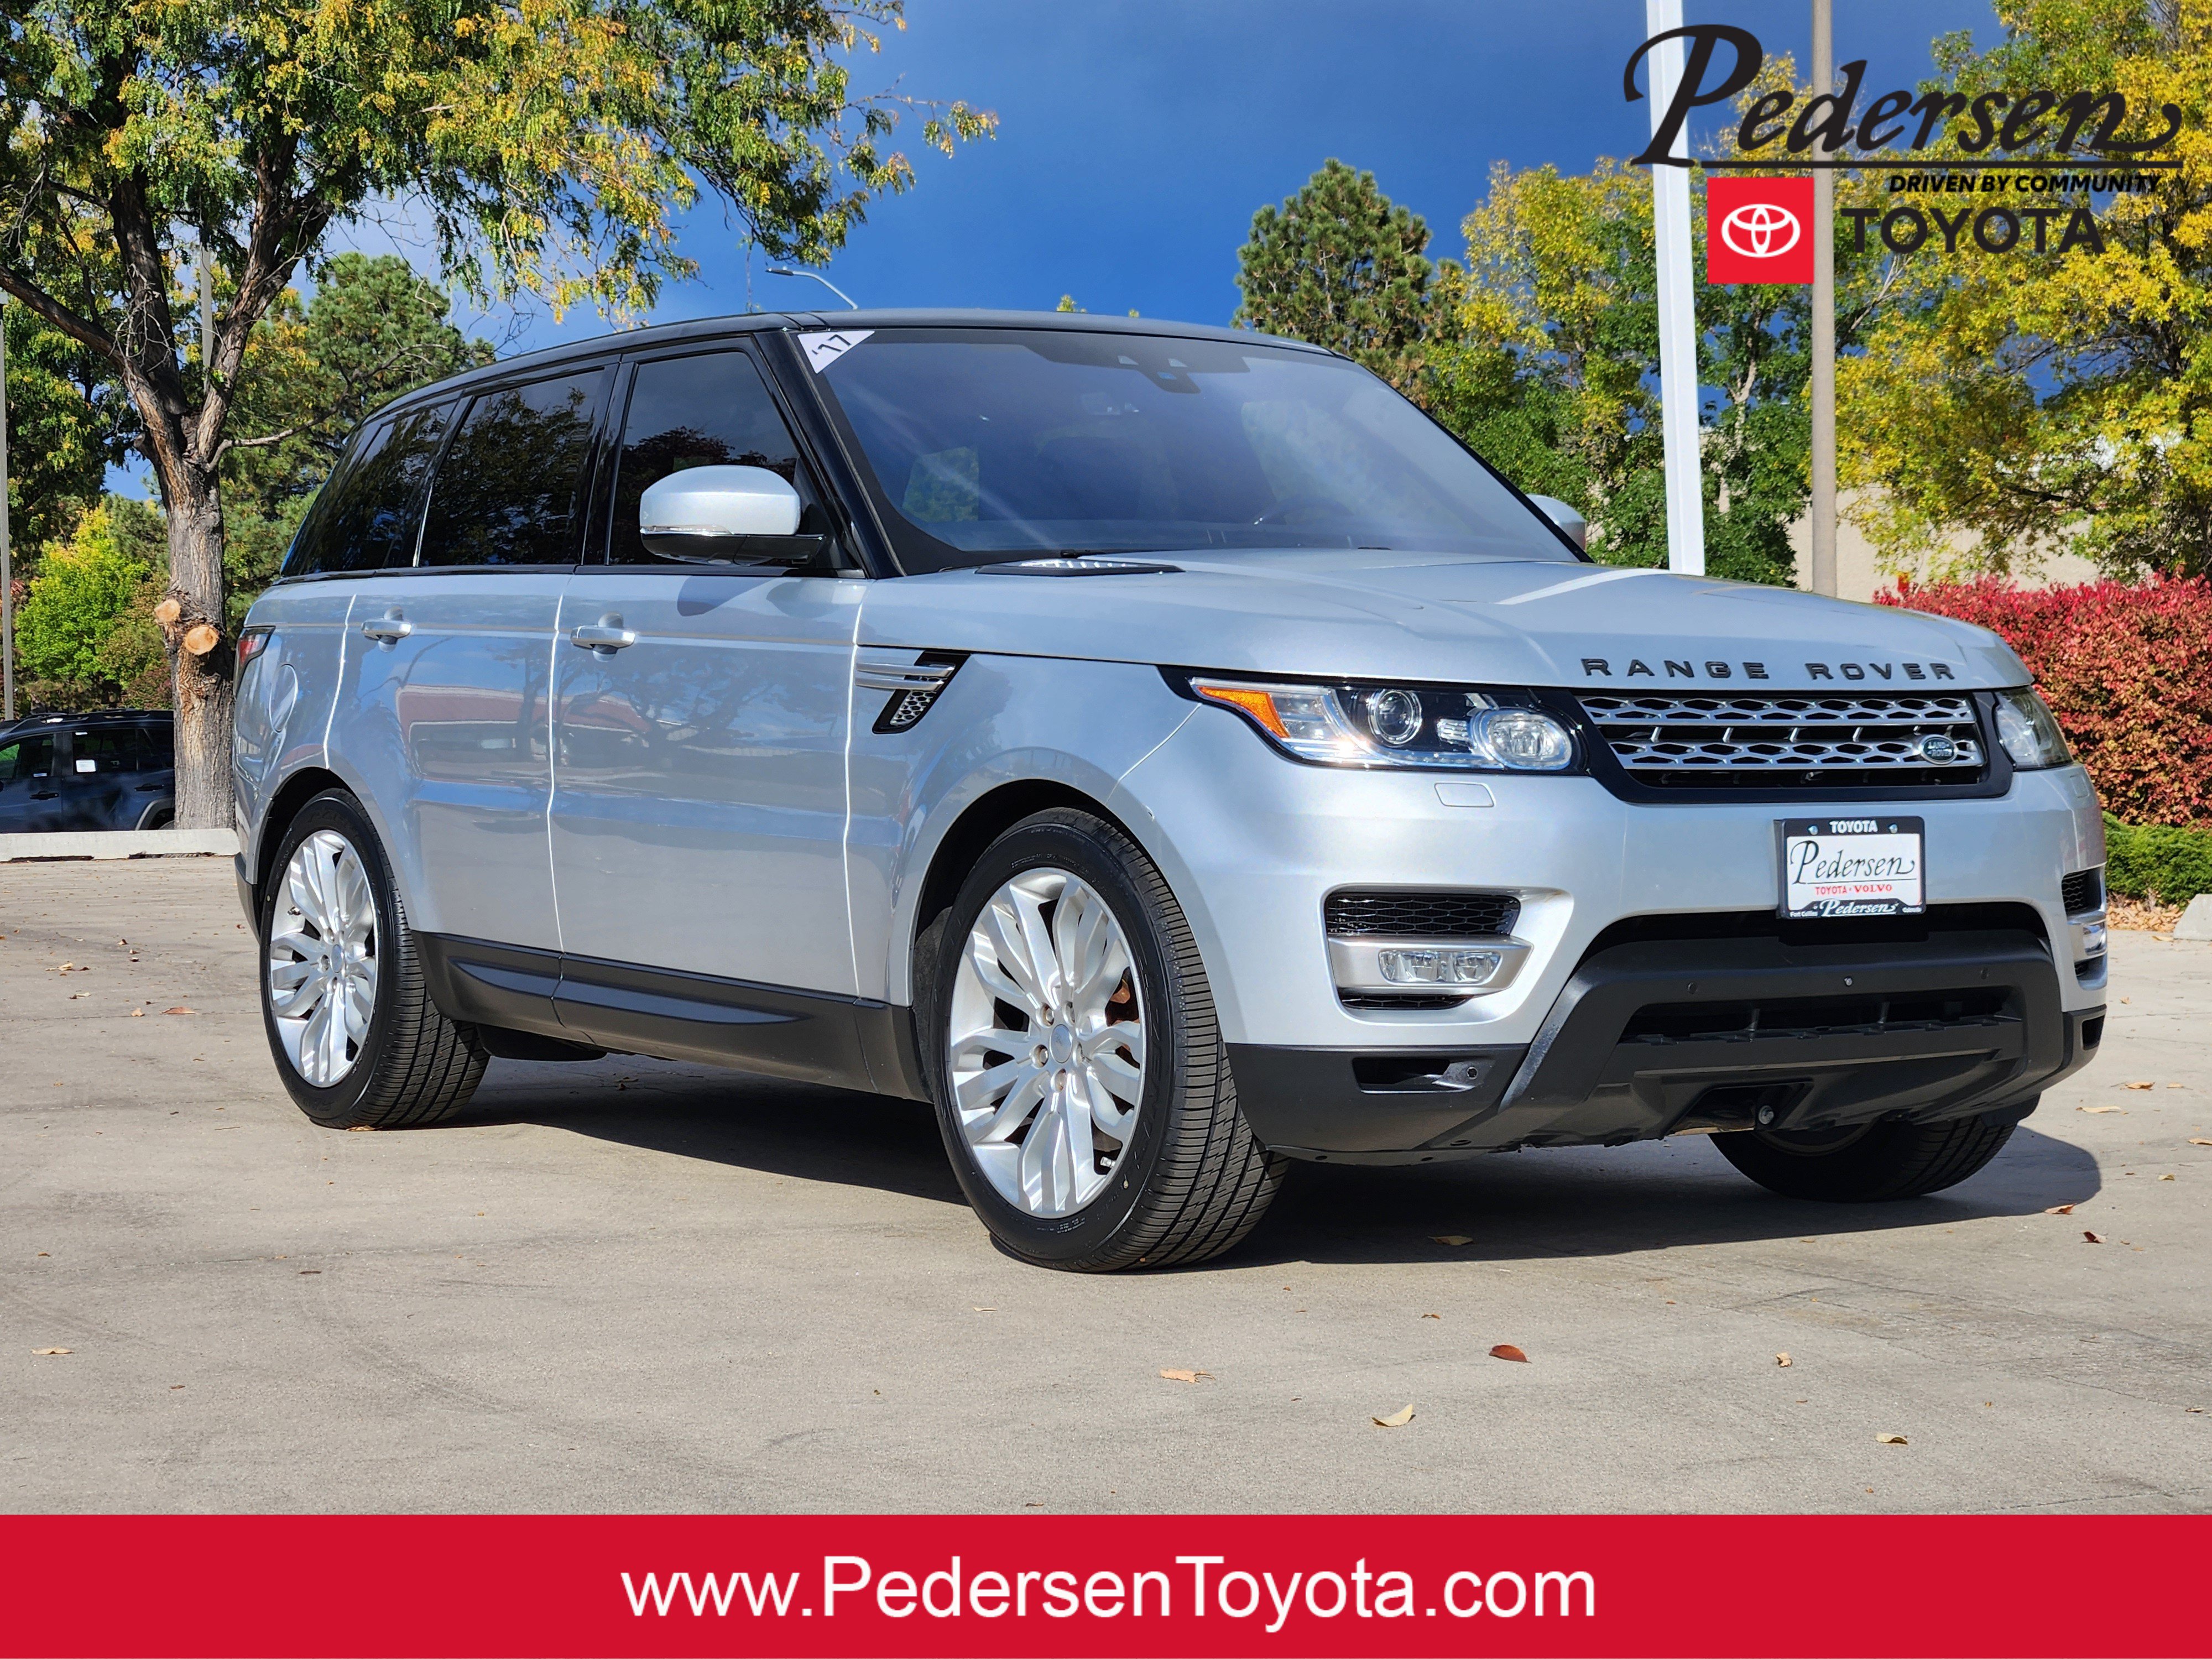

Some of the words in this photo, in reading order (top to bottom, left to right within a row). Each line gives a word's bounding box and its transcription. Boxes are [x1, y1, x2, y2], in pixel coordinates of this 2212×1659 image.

[1580, 658, 1770, 679] RANGE
[1804, 662, 1956, 680] ROVER
[1829, 820, 1878, 833] TOYOTA
[1790, 840, 1916, 885] Pedersen
[1815, 886, 1848, 895] TOYOTA
[1854, 884, 1892, 893] VOLVO
[1819, 898, 1899, 917] Pedersen
